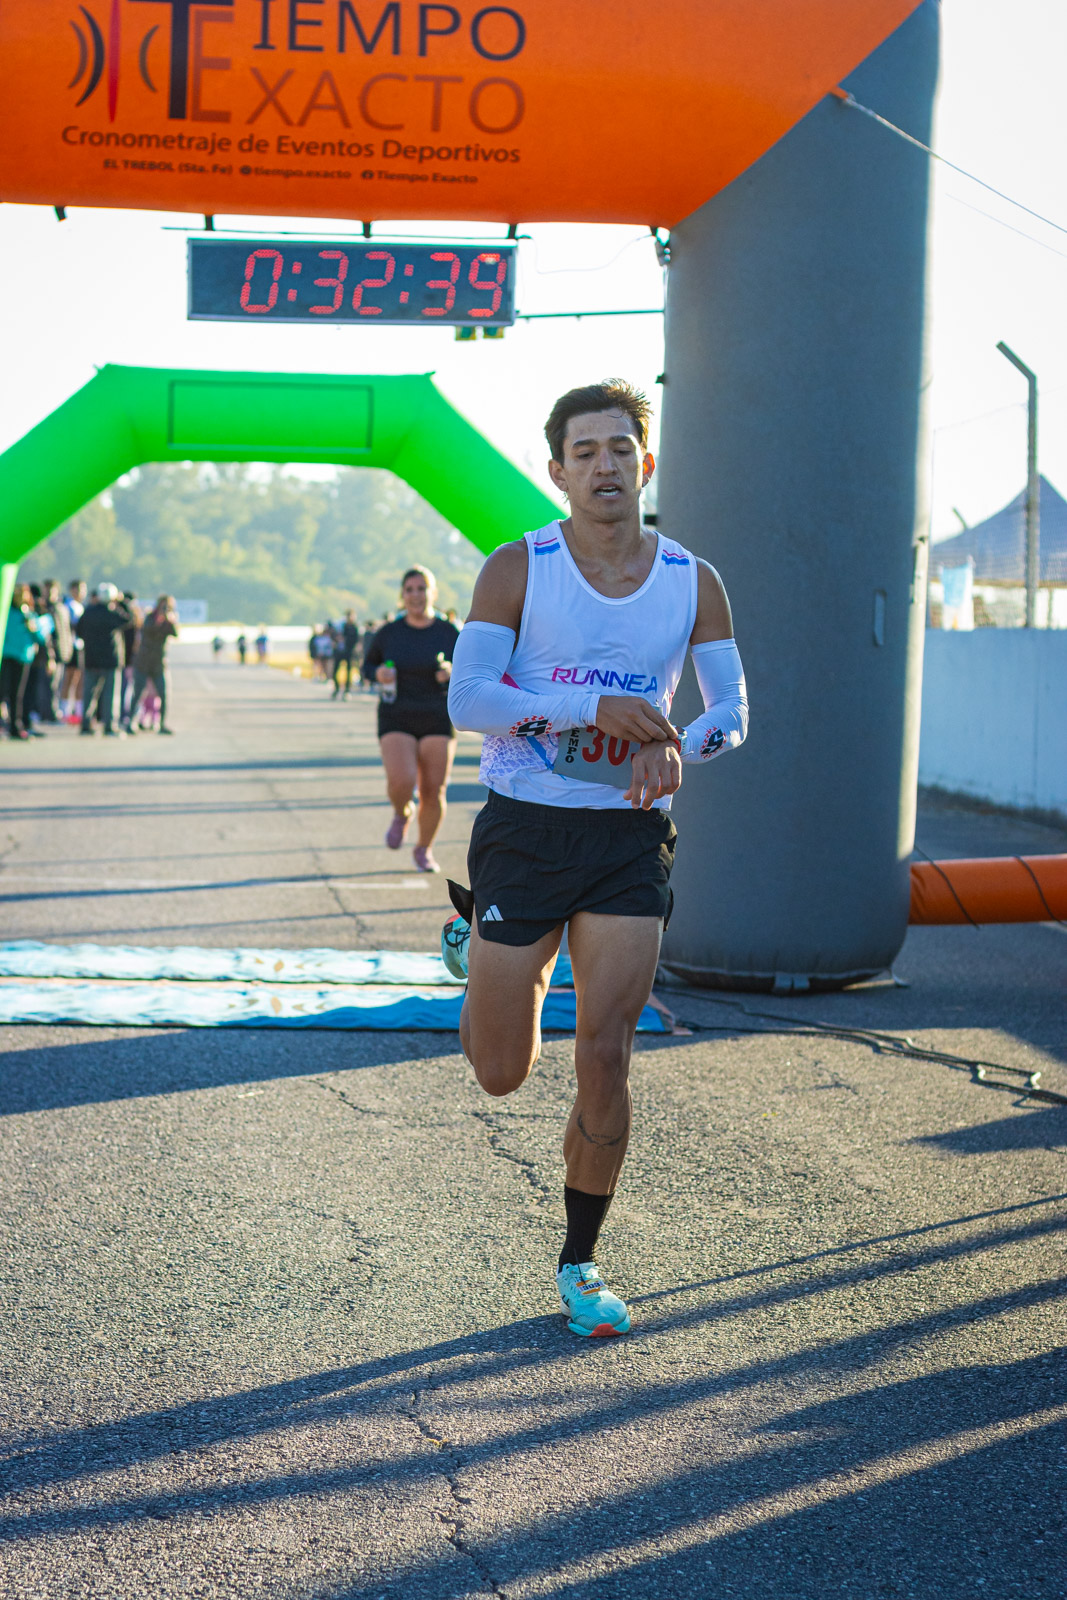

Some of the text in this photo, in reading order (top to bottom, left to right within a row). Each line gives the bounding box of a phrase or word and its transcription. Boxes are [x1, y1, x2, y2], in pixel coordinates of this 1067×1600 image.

[61, 125, 521, 163] Cronometraje de Eventos Deportivos
[376, 170, 478, 184] Tiempo Exacto
[239, 248, 508, 318] 0:32:39
[551, 667, 658, 694] RUNNEA
[565, 727, 580, 764] EMPO
[582, 725, 645, 767] 30
